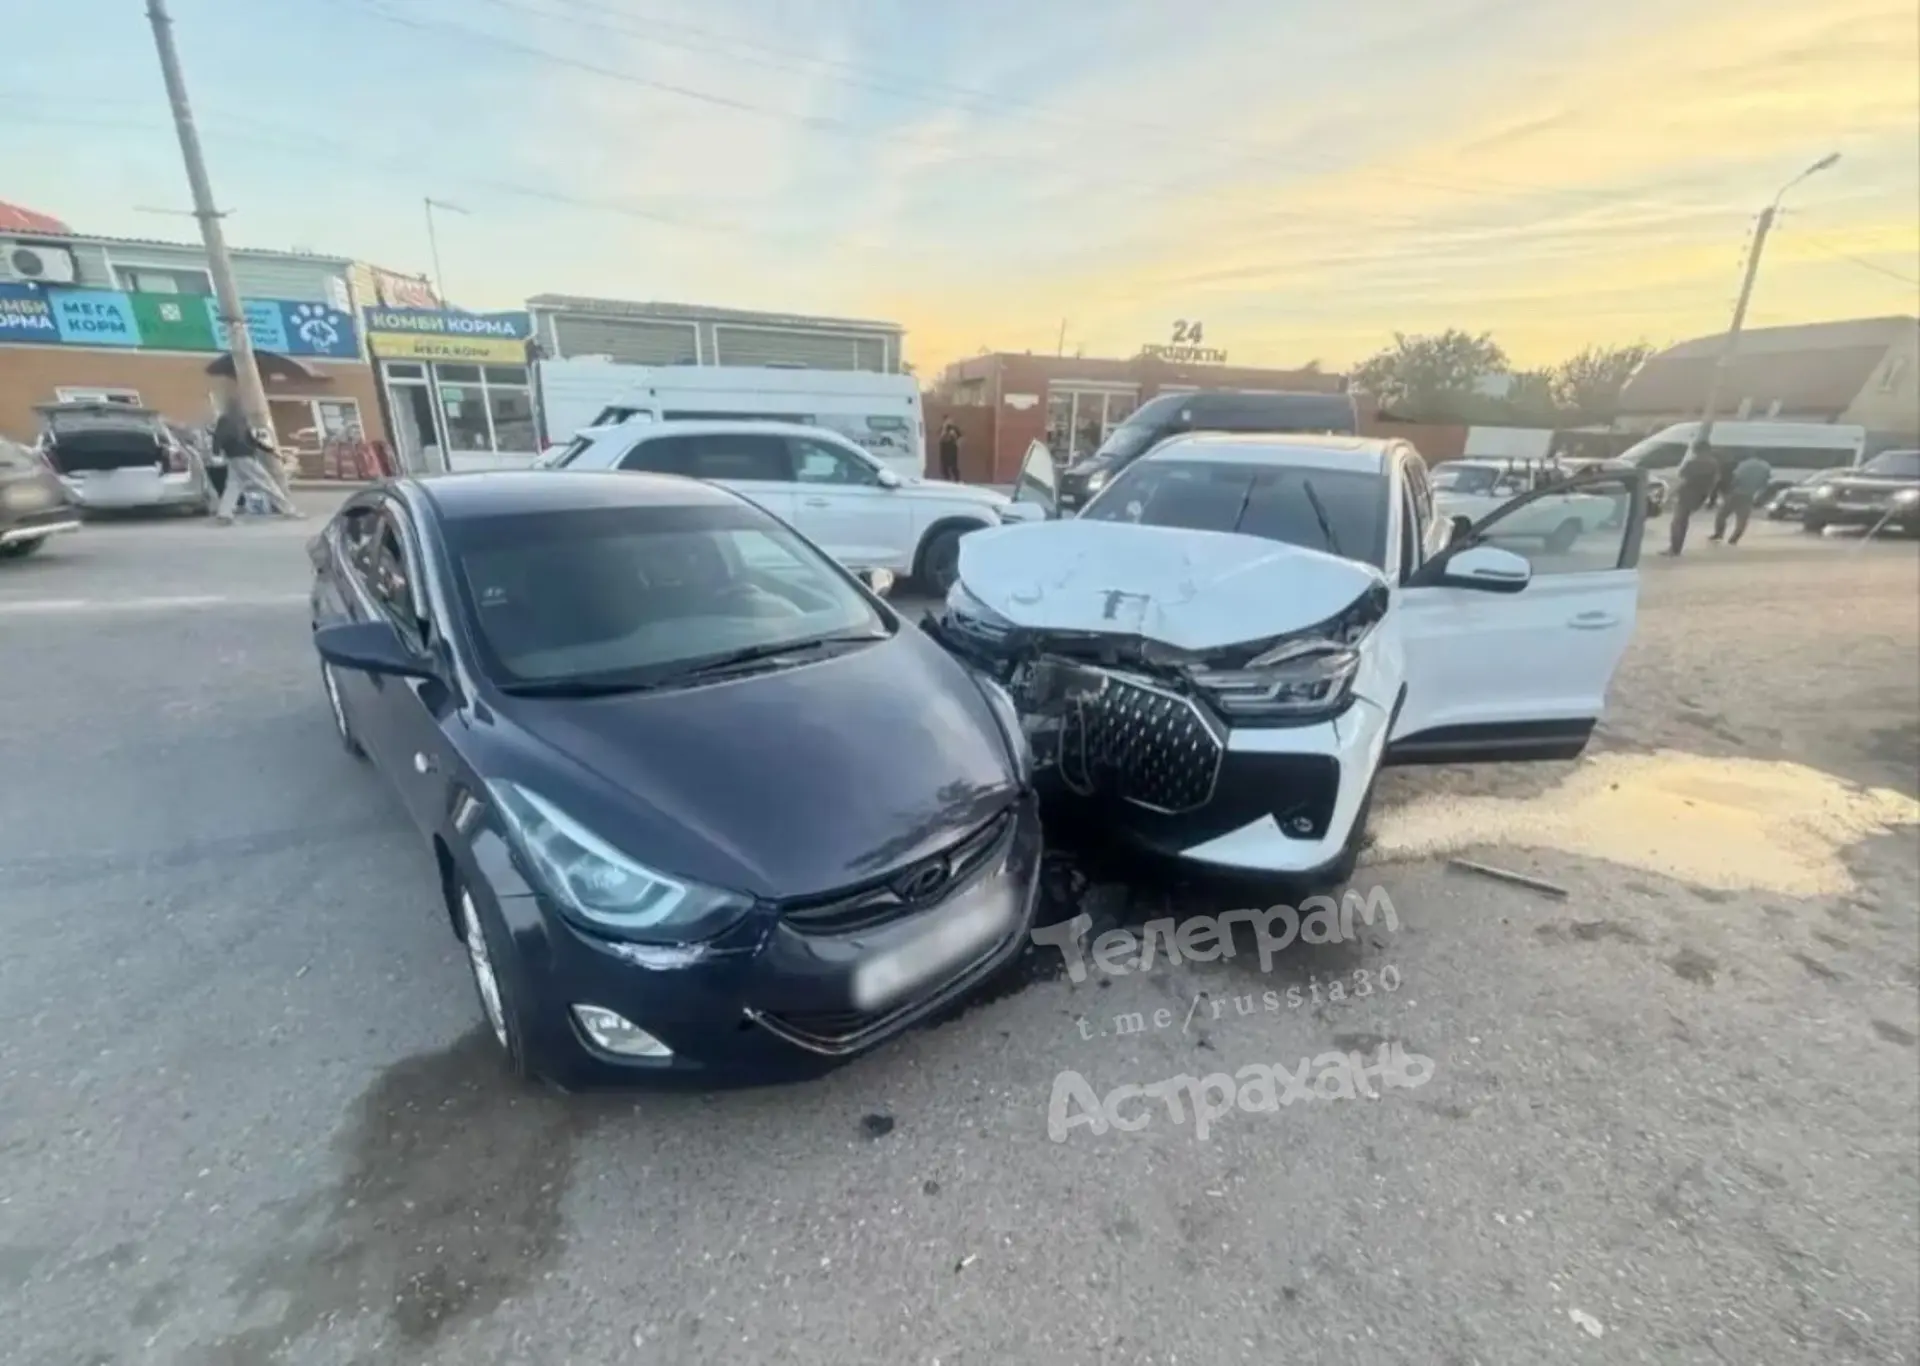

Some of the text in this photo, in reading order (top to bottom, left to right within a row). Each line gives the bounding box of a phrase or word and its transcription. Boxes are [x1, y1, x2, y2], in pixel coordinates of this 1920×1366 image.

[63, 301, 123, 319] МЕГА
[68, 318, 127, 333] КОРМ
[372, 312, 516, 336] КОМБИ КОРМА
[1172, 320, 1202, 343] 24
